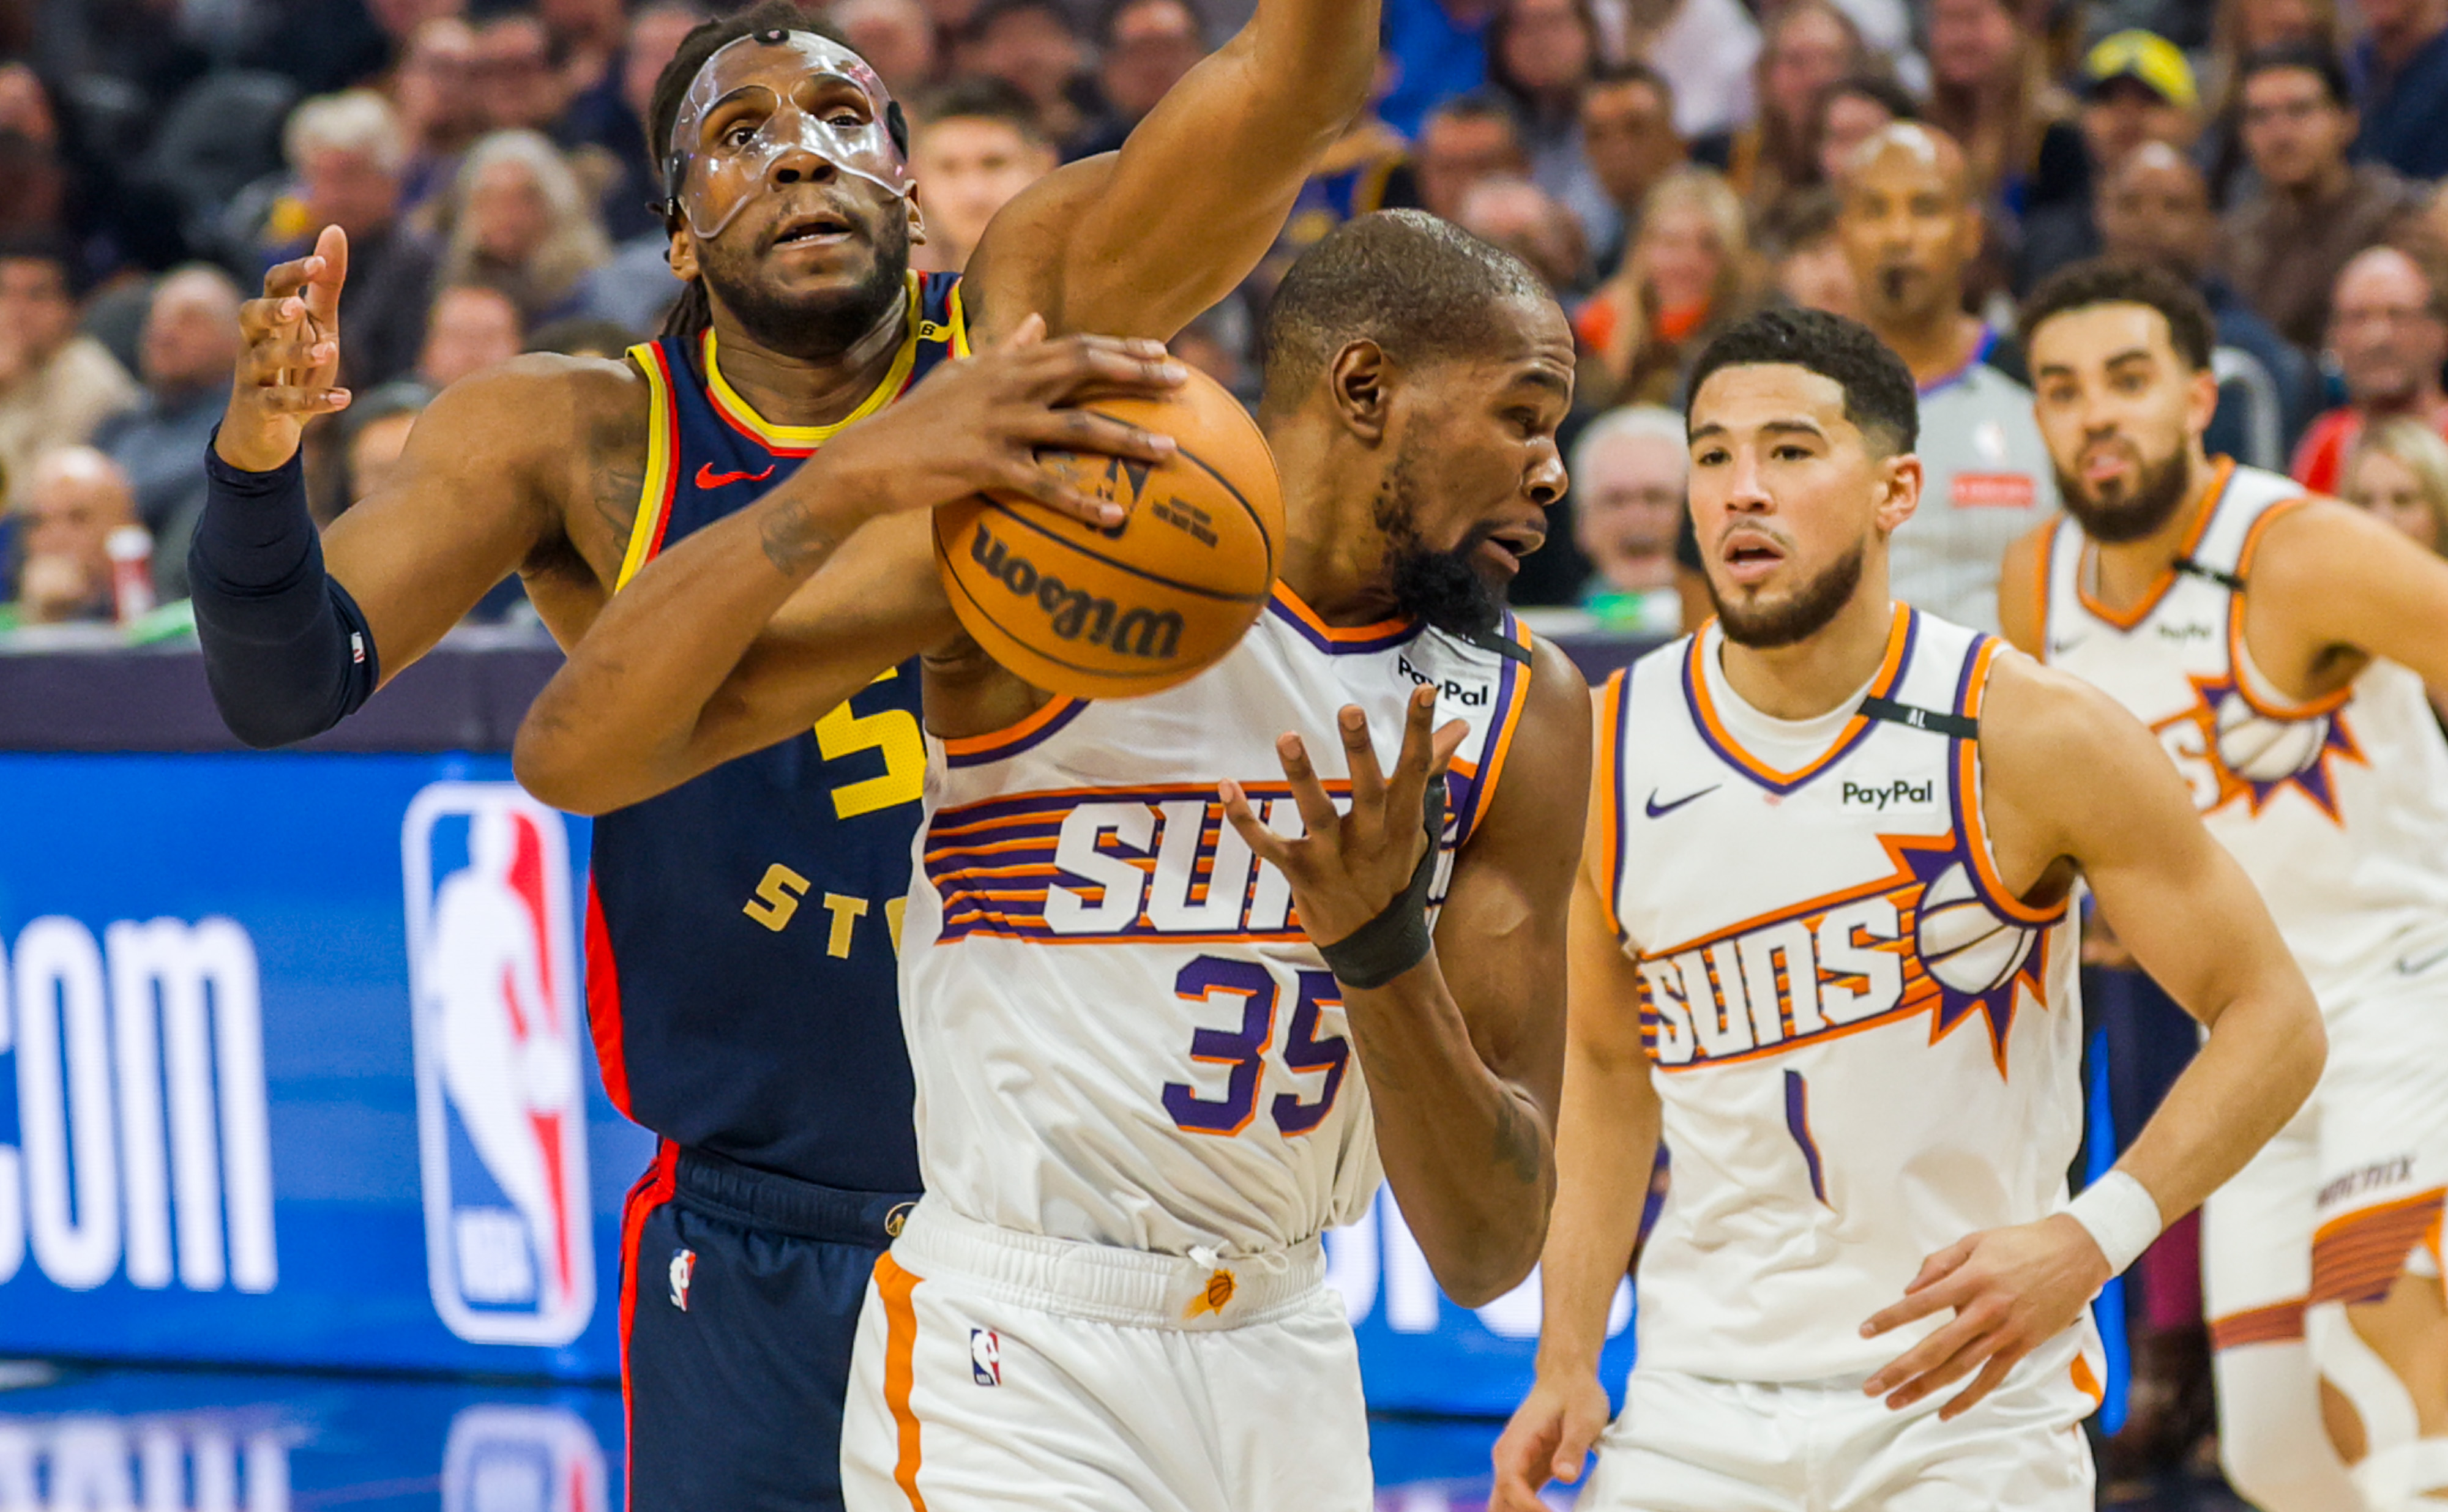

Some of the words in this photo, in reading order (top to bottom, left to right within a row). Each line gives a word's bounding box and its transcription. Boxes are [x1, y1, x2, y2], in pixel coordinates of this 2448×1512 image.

[971, 522, 1185, 660] Wilson
[1908, 708, 1926, 728] AL
[1043, 797, 1353, 934] SUN
[1843, 779, 1933, 812] PayPal
[1162, 953, 1351, 1138] 35
[1639, 896, 1905, 1066] SUNS
[0, 913, 279, 1295] om
[1783, 1068, 1836, 1210] 1
